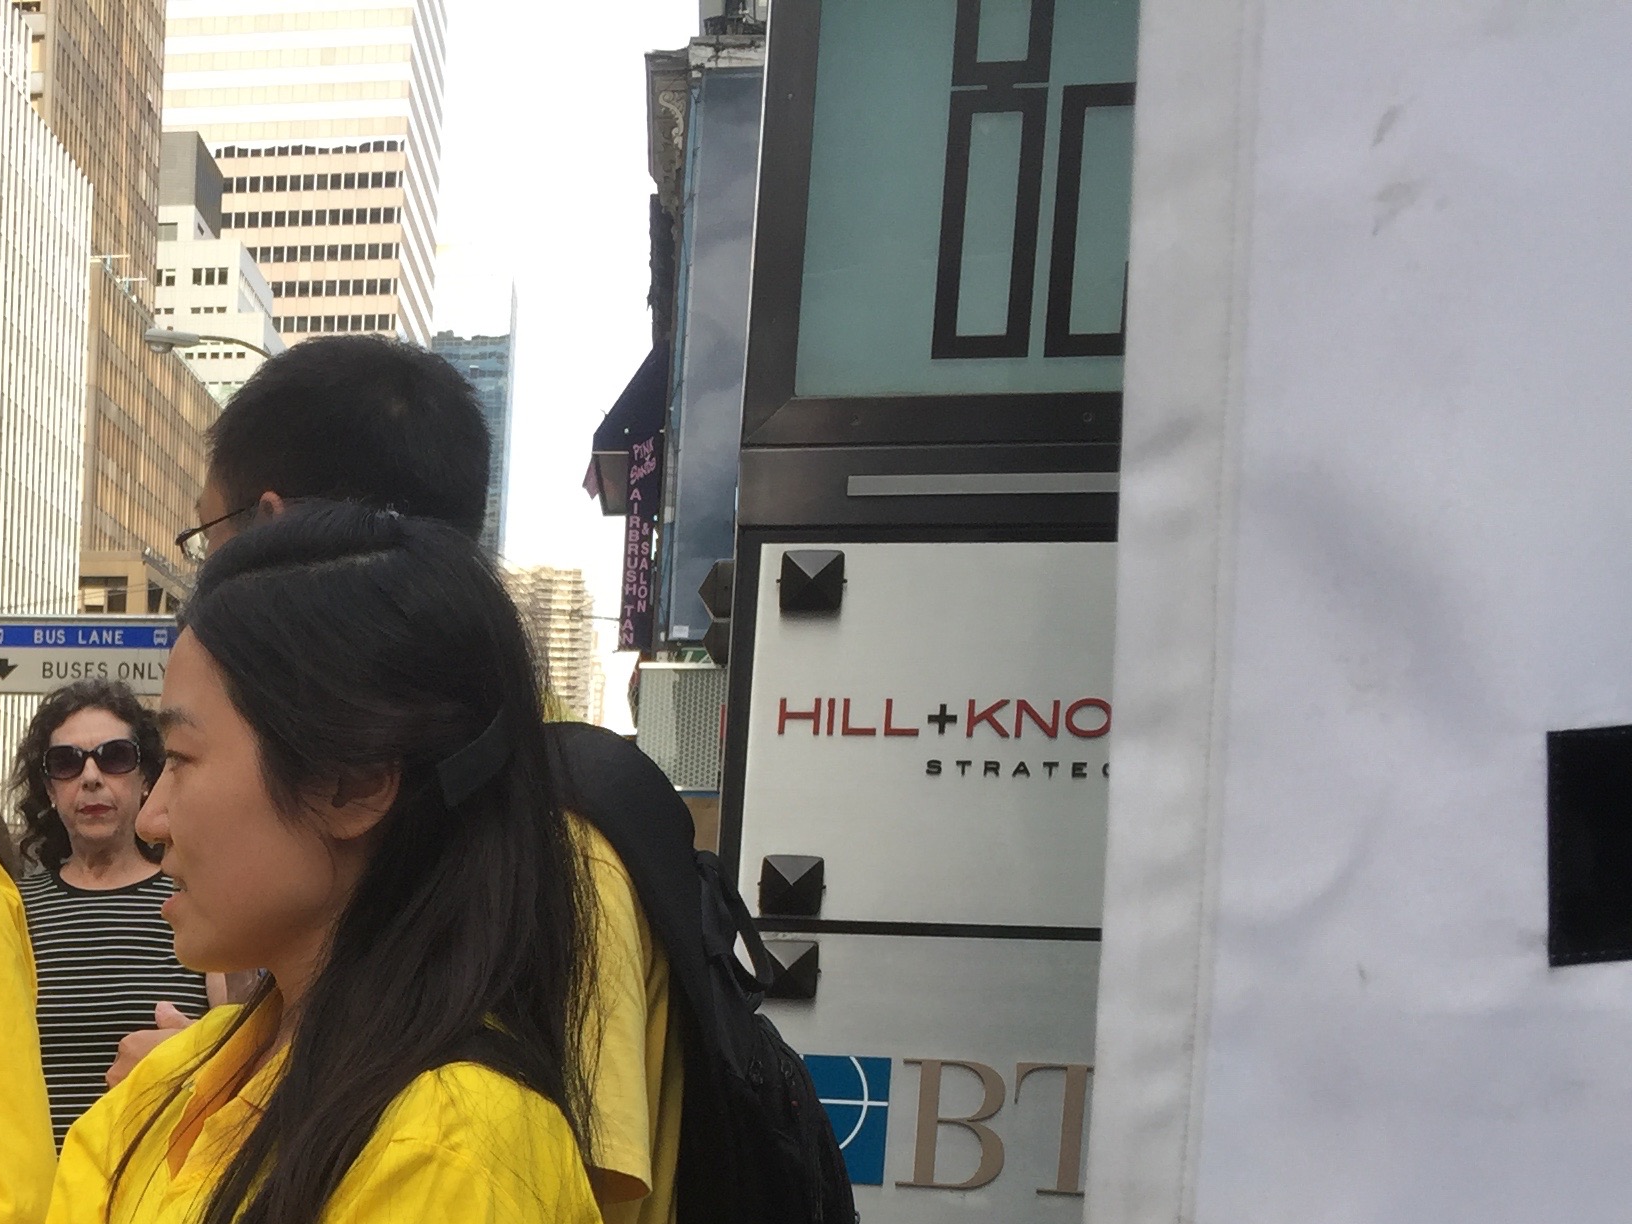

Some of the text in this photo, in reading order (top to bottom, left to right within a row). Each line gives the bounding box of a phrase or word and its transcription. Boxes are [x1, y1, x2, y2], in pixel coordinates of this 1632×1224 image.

[622, 488, 642, 645] AIRBRUSH TAN
[636, 522, 650, 613] & SALON
[33, 629, 124, 646] BUS LANE
[42, 661, 167, 681] BUSES ONLY
